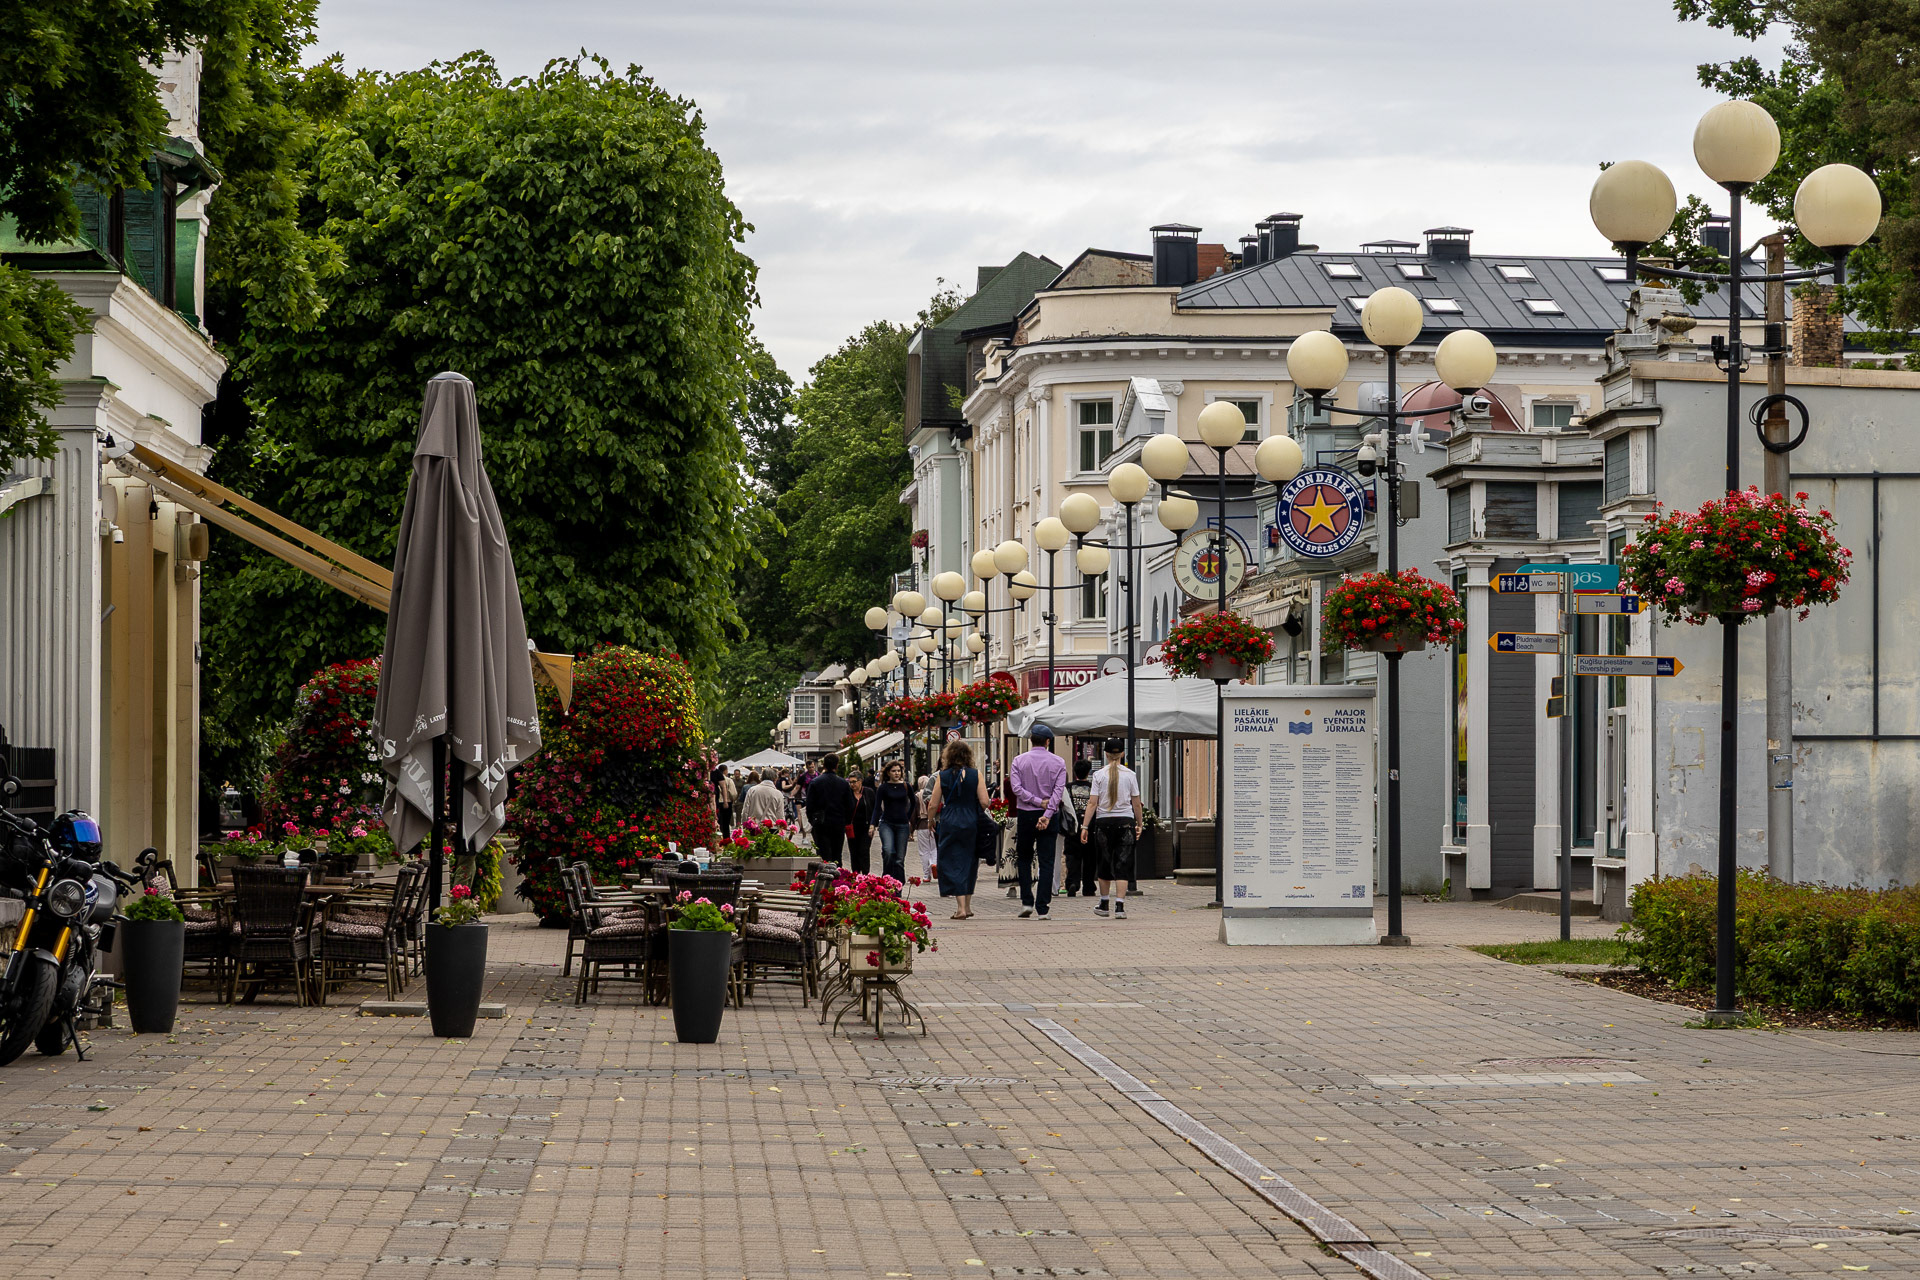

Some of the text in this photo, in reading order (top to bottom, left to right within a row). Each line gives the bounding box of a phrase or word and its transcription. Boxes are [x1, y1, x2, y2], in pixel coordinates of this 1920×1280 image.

[1282, 473, 1357, 503] KLONDAIKA
[1305, 543, 1339, 553] SPĒLES
[1339, 519, 1359, 546] GARŠU
[1516, 636, 1543, 644] Pludmale
[1579, 665, 1610, 673] Rivership
[1234, 708, 1269, 716] LIELĀKIE
[1234, 716, 1279, 724] PASĀKUMI
[1323, 717, 1366, 725] EVENTS IN
[1234, 724, 1274, 732] JŪRMALĀ
[1325, 724, 1366, 733] JŪRMALA
